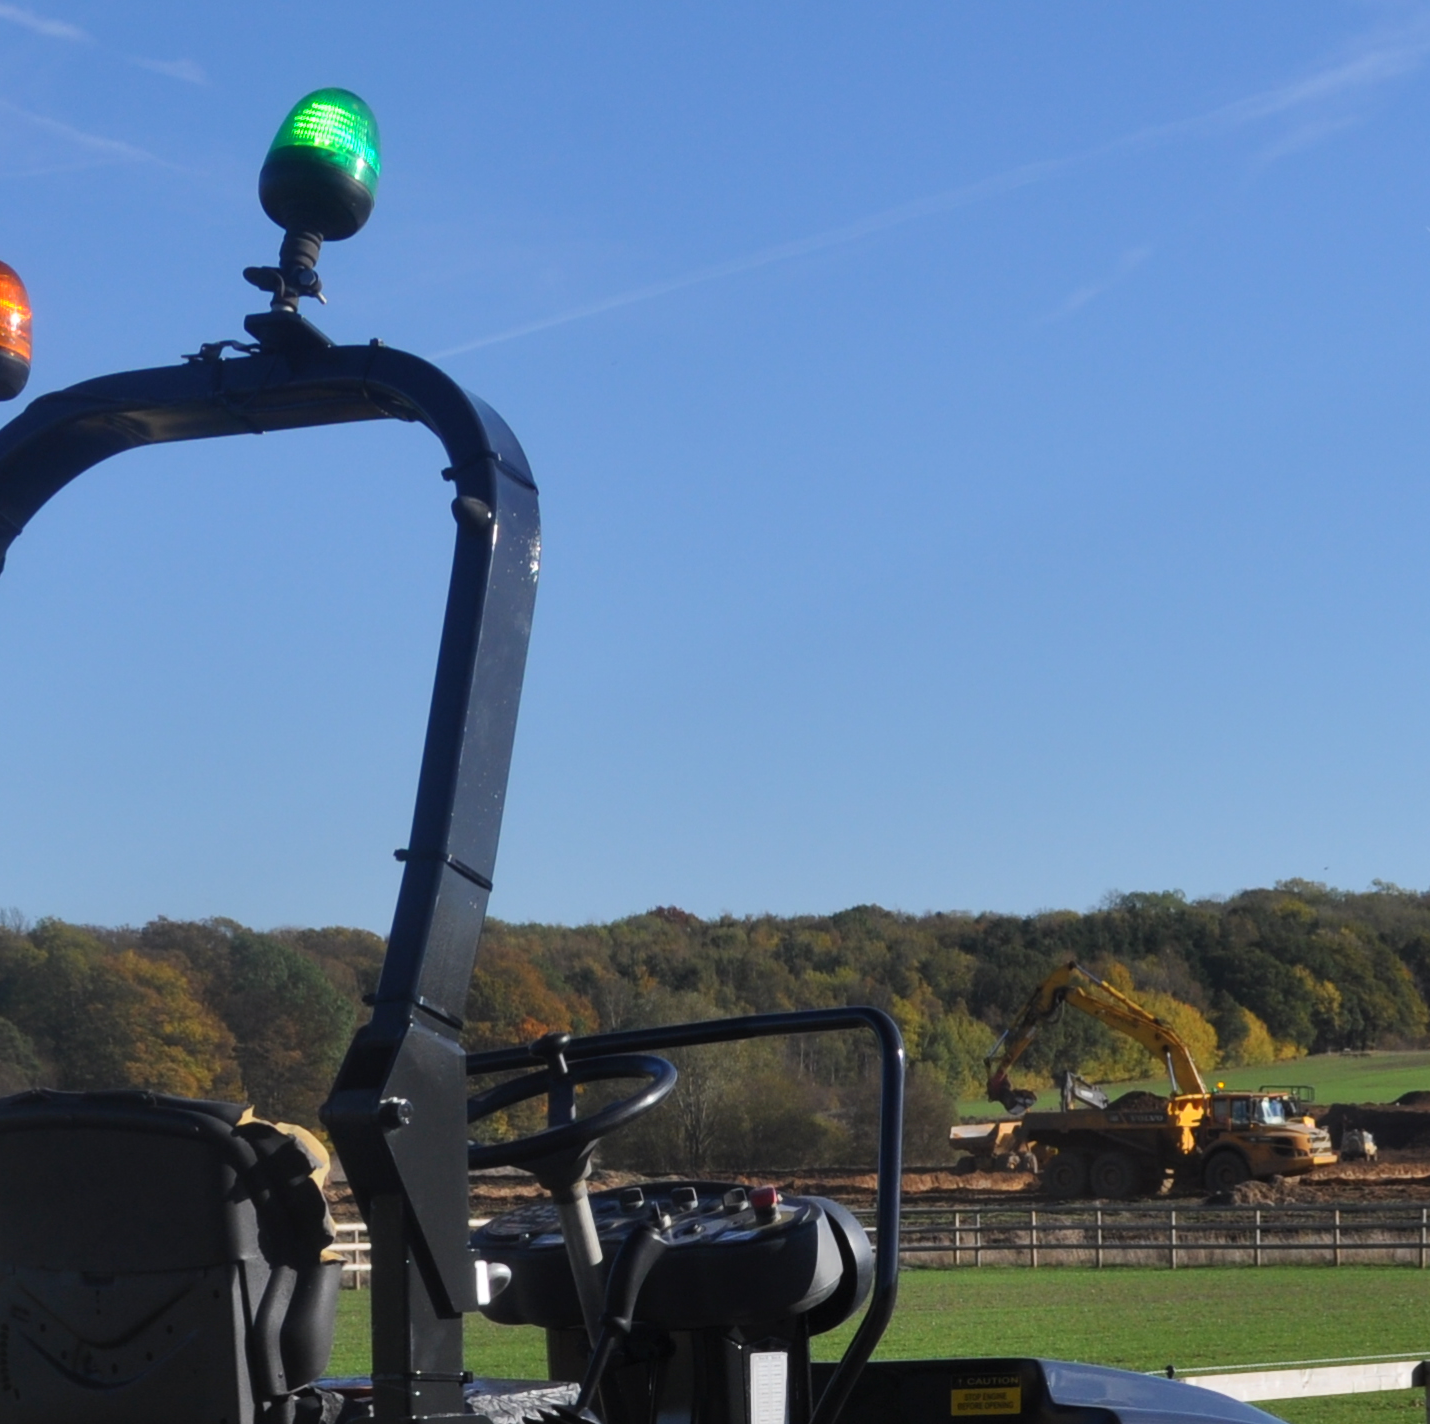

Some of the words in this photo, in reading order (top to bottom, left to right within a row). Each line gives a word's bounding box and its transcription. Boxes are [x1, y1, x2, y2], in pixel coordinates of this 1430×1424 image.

[966, 1376, 1019, 1386] CAUTION
[964, 1393, 981, 1401] STOP
[983, 1392, 1007, 1401] ENGINE
